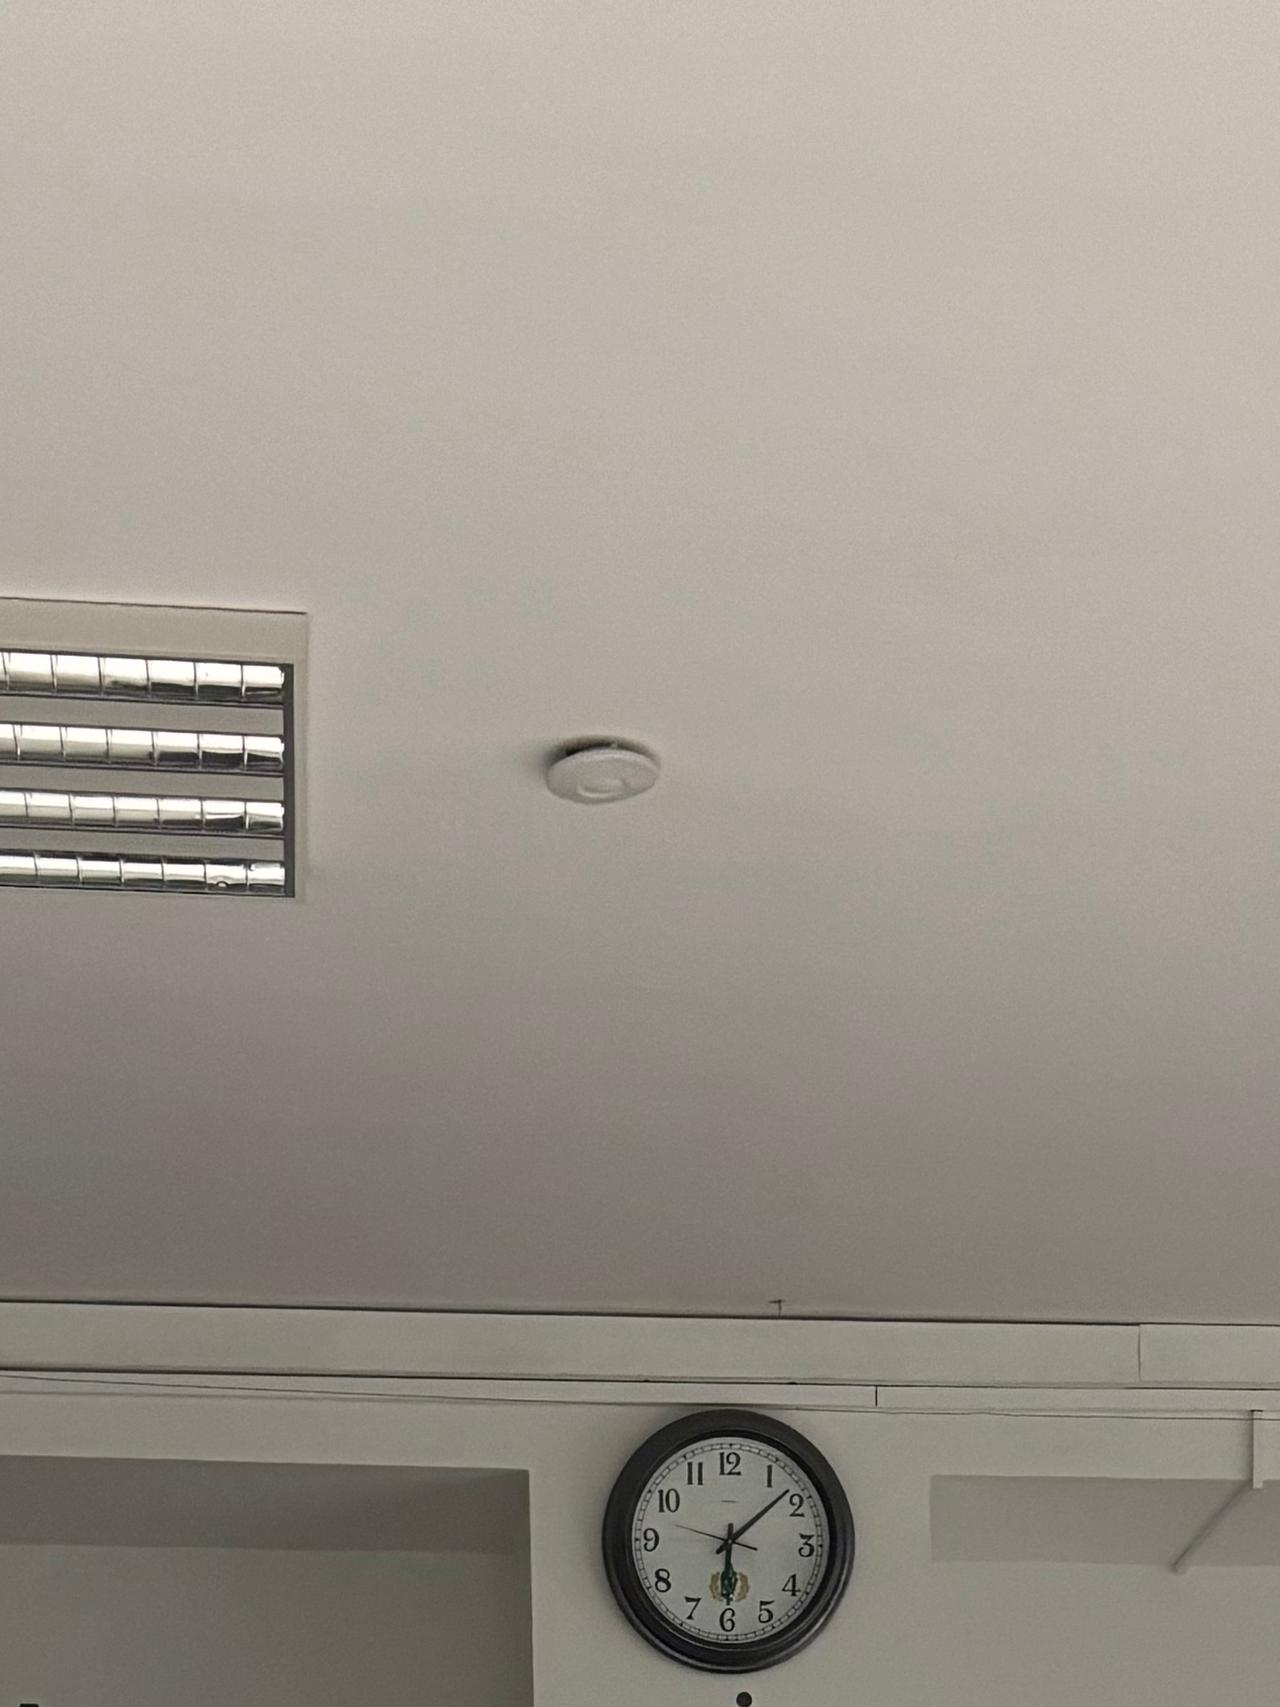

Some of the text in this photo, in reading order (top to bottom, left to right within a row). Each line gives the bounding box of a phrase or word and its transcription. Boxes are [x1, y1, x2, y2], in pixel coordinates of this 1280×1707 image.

[687, 1462, 703, 1485] 11
[720, 1452, 741, 1475] 12
[658, 1488, 680, 1512] 10
[789, 1494, 805, 1517] 2
[643, 1528, 659, 1552] 9
[799, 1533, 814, 1557] 3
[655, 1568, 671, 1592] 8
[782, 1574, 801, 1596] 4
[684, 1596, 702, 1619] 7
[758, 1600, 775, 1623] 5
[720, 1608, 735, 1631] 6
